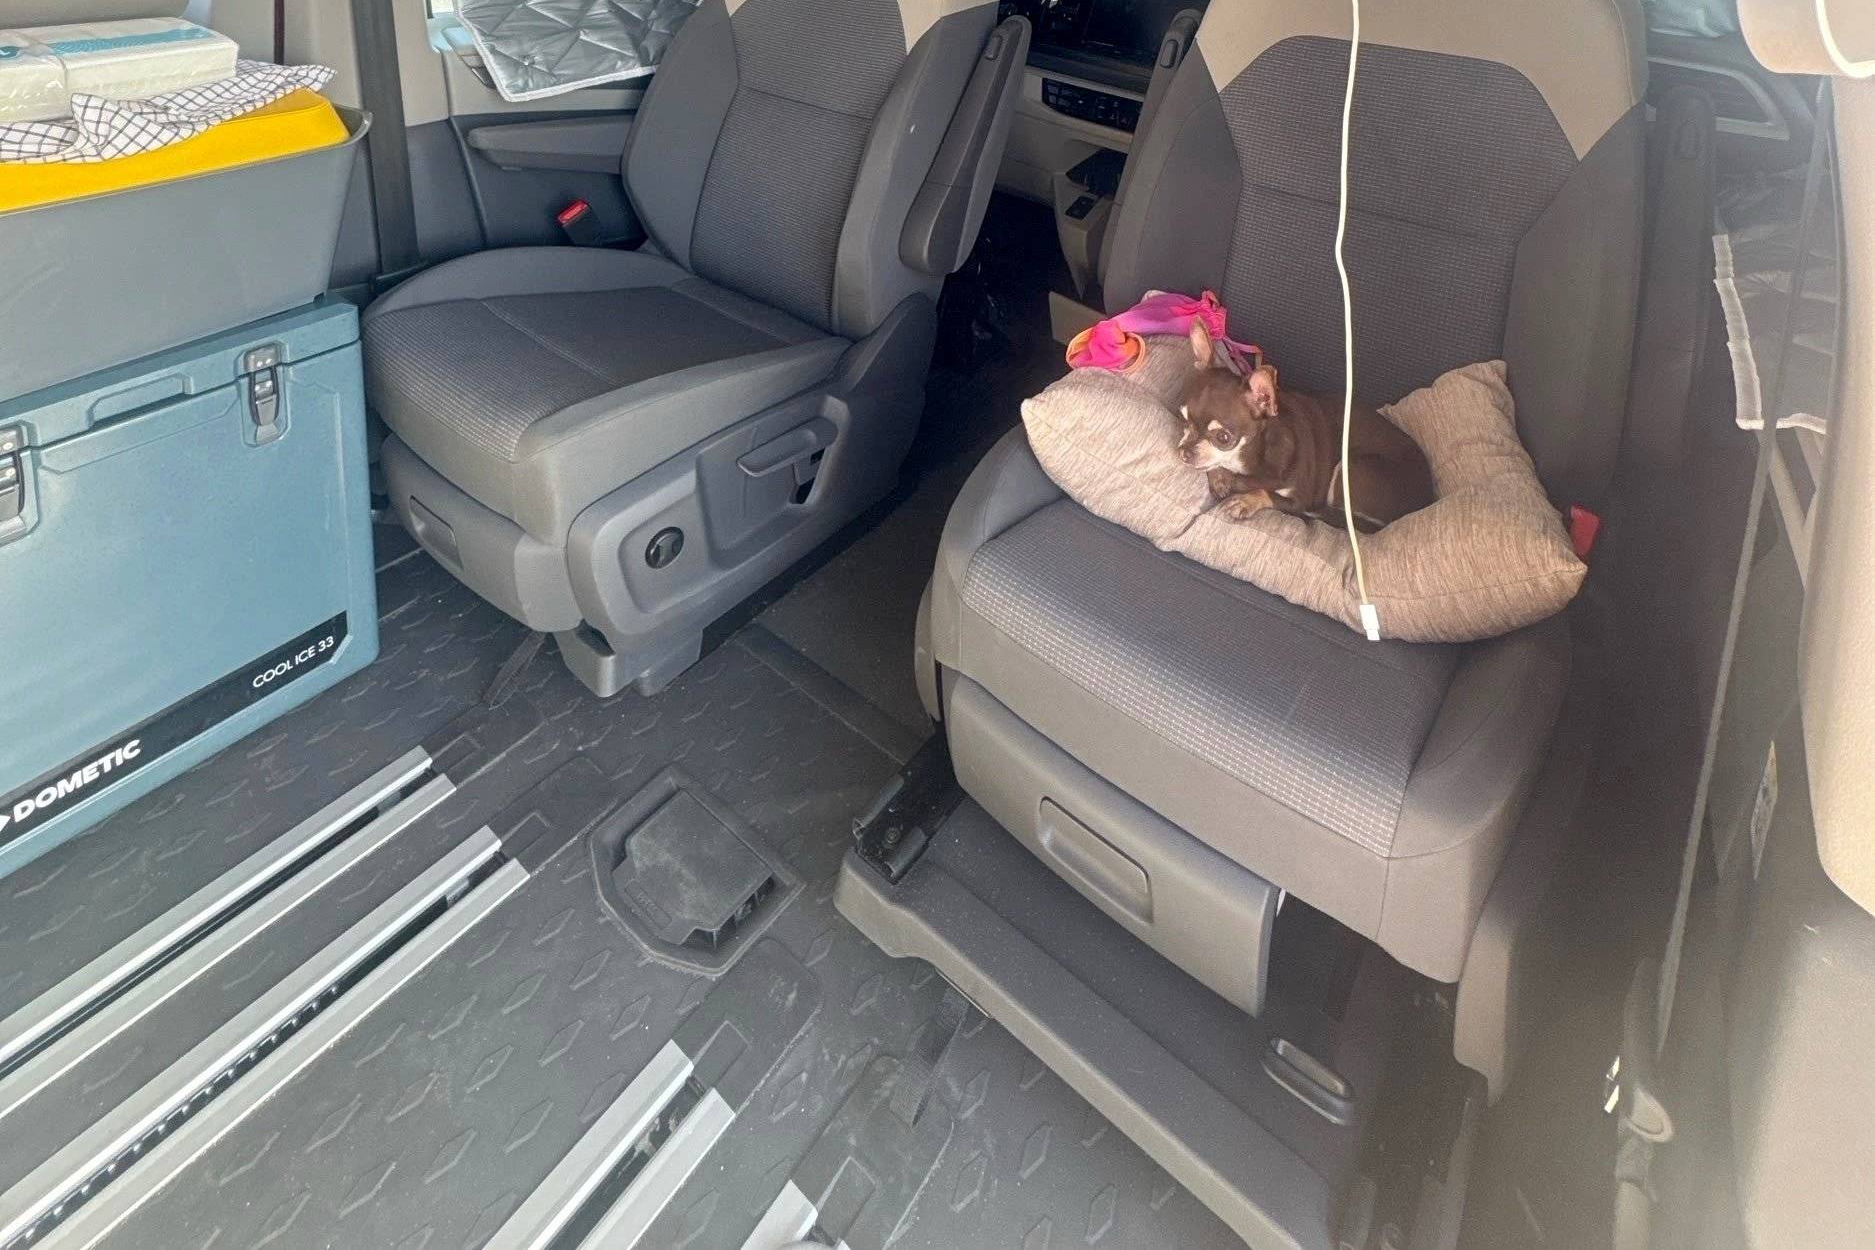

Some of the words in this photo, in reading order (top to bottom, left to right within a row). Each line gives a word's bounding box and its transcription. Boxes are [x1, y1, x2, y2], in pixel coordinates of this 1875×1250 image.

[252, 660, 293, 688] COOL
[295, 645, 316, 665] ICE
[318, 635, 335, 652] 33
[13, 739, 141, 823] DOMETIC
